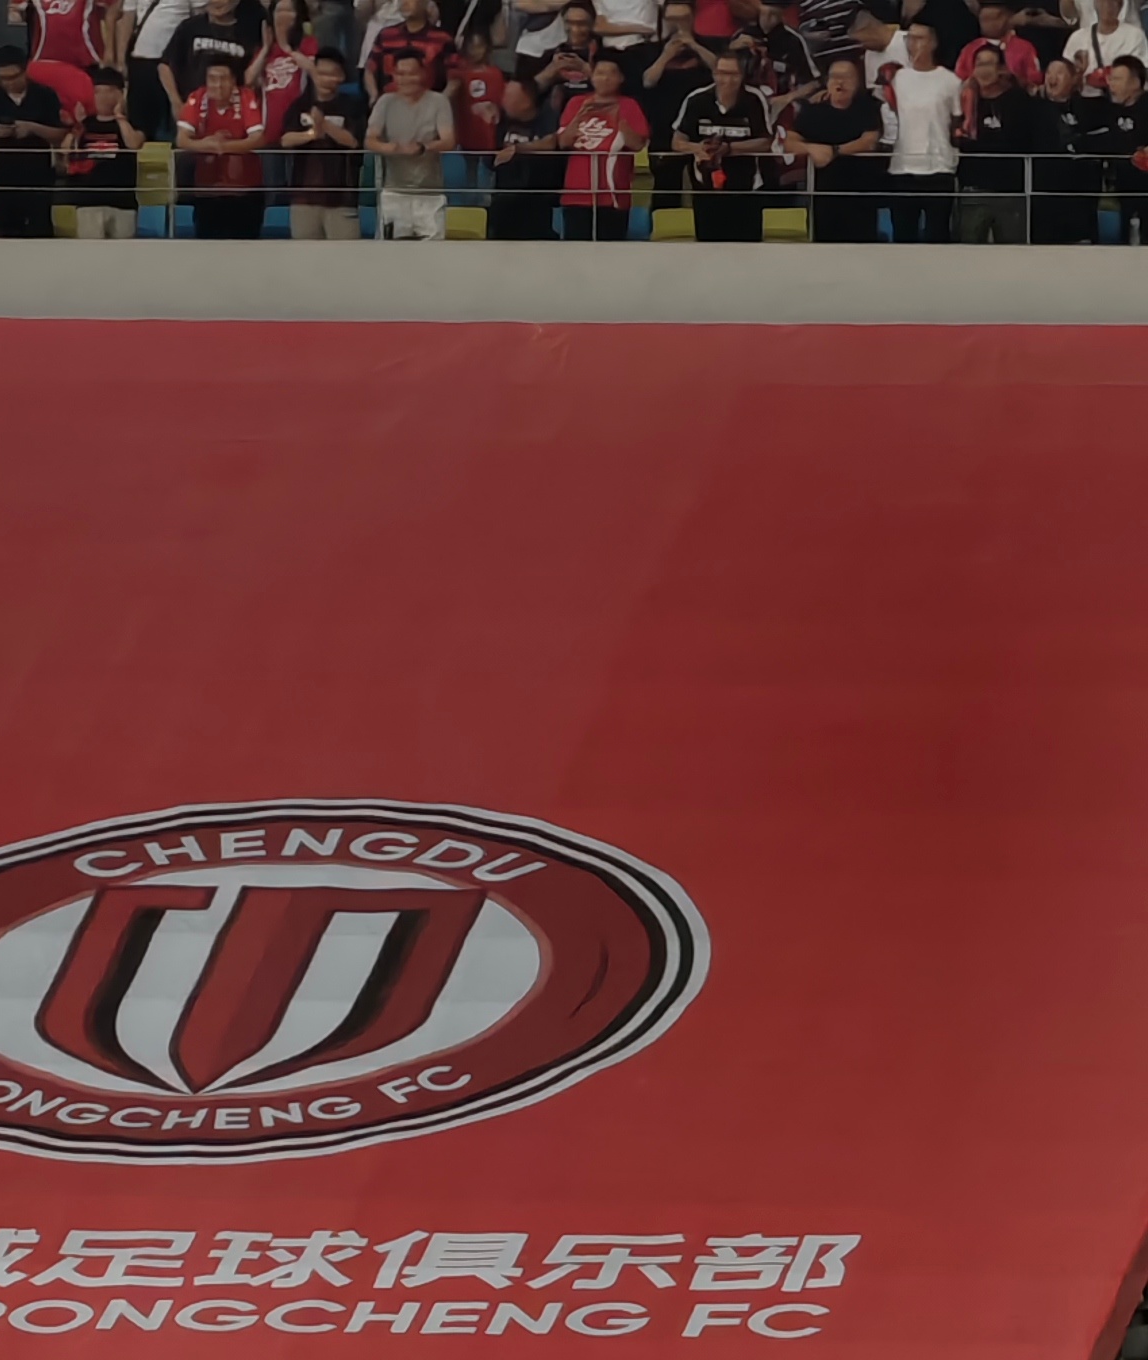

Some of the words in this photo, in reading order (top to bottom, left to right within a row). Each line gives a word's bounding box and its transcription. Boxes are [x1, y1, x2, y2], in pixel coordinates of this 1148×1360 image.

[73, 828, 548, 886] CHENGDU
[378, 1065, 472, 1106] FC
[681, 1302, 831, 1339] FC
